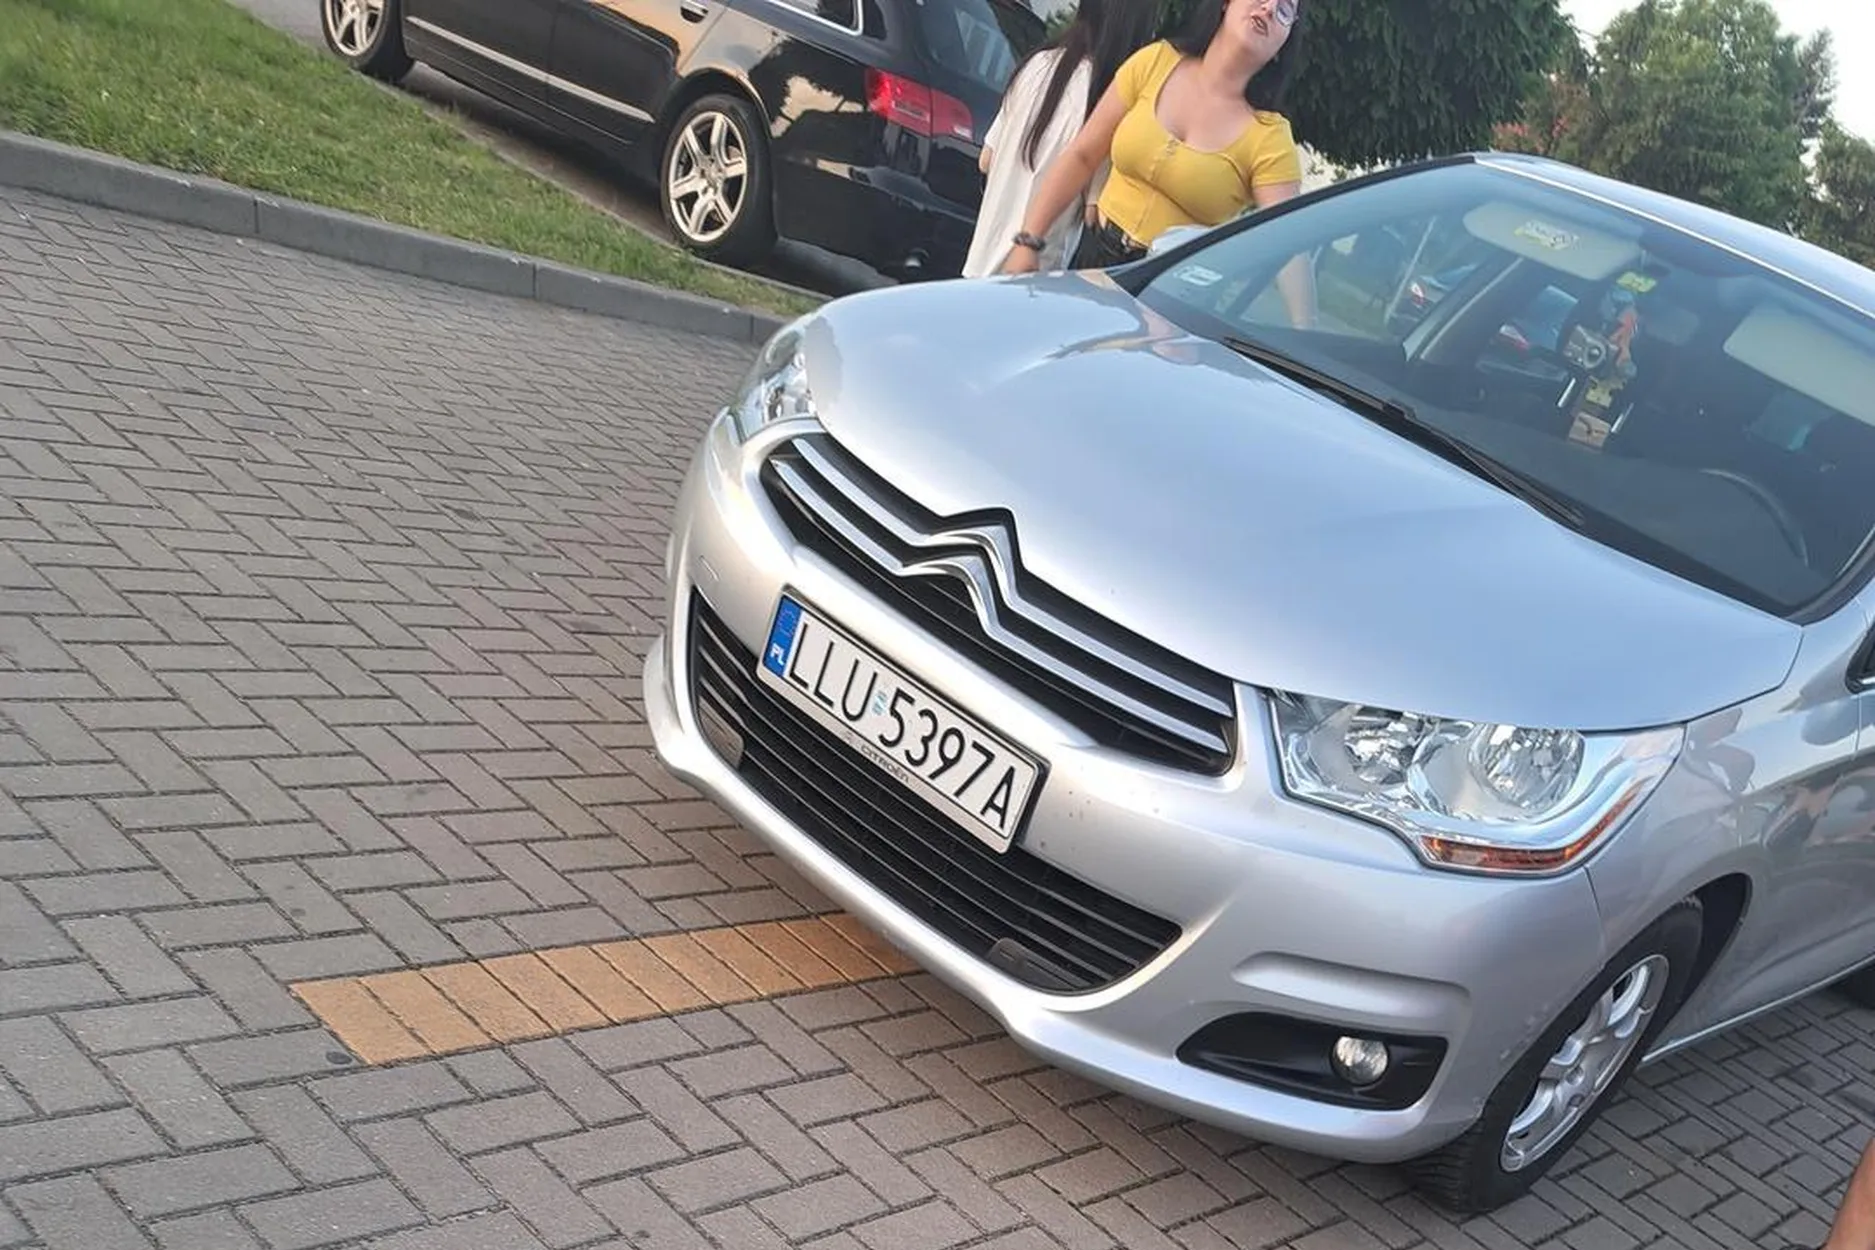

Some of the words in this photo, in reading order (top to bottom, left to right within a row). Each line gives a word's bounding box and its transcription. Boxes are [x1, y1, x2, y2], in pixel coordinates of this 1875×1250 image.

[770, 642, 785, 666] PL
[789, 622, 878, 722] LLU
[878, 687, 1016, 830] 5397A
